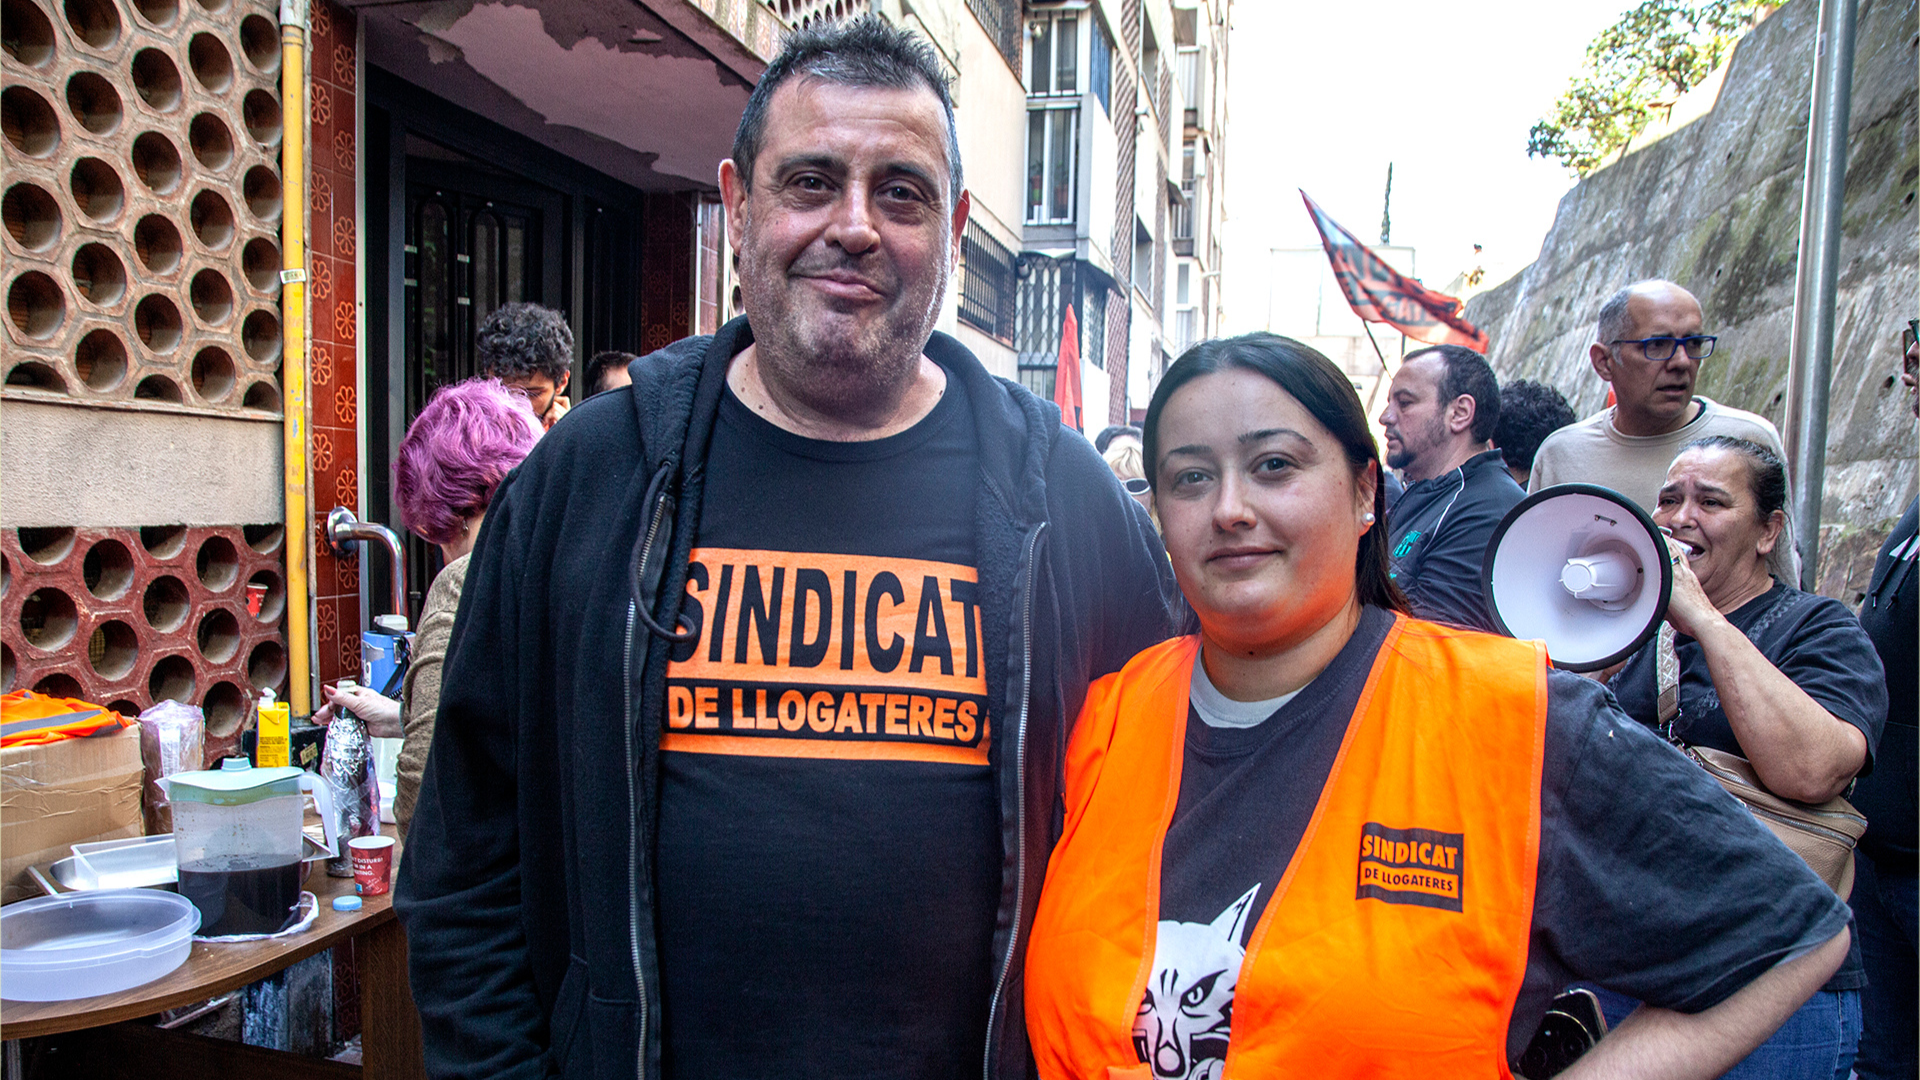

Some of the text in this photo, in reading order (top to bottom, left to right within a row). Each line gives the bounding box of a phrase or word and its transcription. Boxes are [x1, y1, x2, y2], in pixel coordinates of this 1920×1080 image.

[667, 560, 981, 678] SINDICAT
[668, 686, 979, 743] DE LLOGATERES
[1362, 834, 1459, 870] SINDICAT
[1365, 867, 1453, 892] DE LLOGATERES
